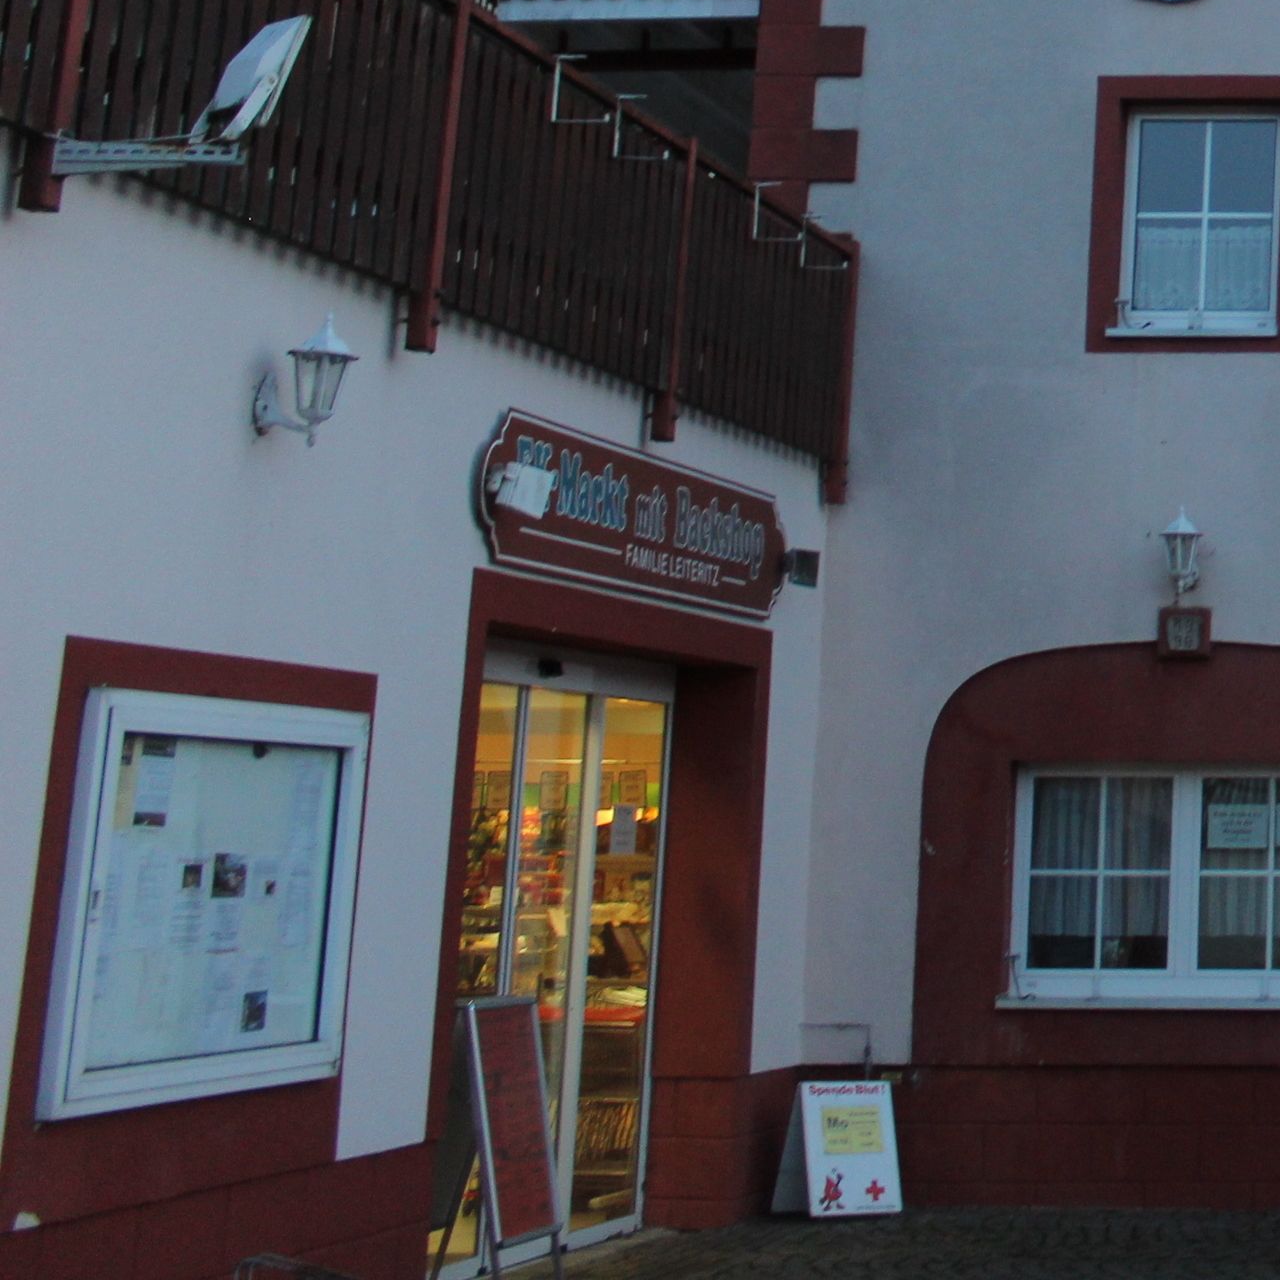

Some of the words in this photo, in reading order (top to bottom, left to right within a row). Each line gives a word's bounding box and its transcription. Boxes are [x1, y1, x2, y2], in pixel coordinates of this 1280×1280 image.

[624, 543, 669, 575] FAMILIE
[634, 485, 667, 543] mit
[674, 486, 765, 580] Backshop
